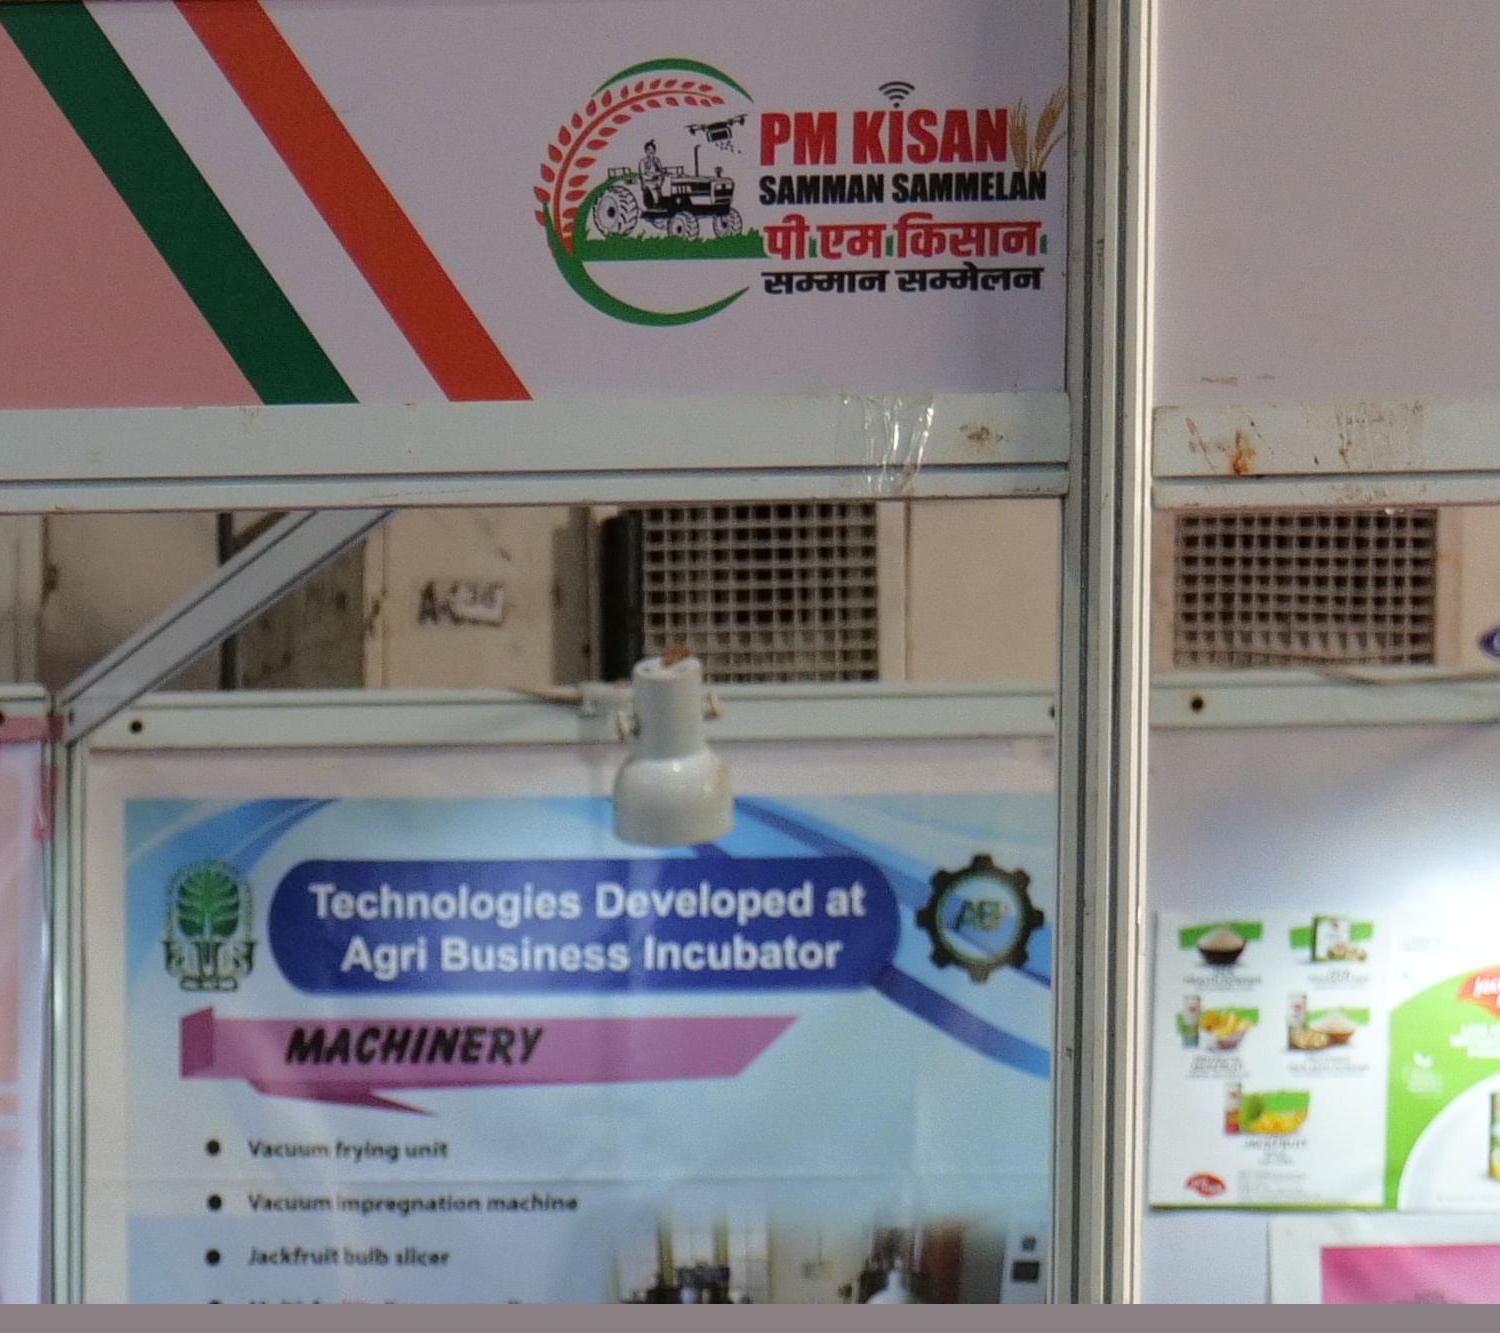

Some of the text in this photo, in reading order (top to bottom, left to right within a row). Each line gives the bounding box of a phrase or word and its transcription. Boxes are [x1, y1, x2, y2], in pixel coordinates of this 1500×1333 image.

[760, 108, 1007, 166] PM KISAN
[759, 171, 1047, 205] SAMMAN SAMMELAN
[763, 212, 1042, 260] पी एम किसान
[761, 262, 1045, 294] सम्मान सम्मेलन
[309, 881, 866, 926] Technologies Developed at
[342, 933, 843, 981] Agri Business Incubator
[285, 1024, 544, 1067] MACHINERY
[248, 1139, 448, 1162] Vacuum frying unit
[248, 1193, 579, 1216] Vacuum impregnation machine
[248, 1246, 450, 1266] Jackfruit bulb slicer
